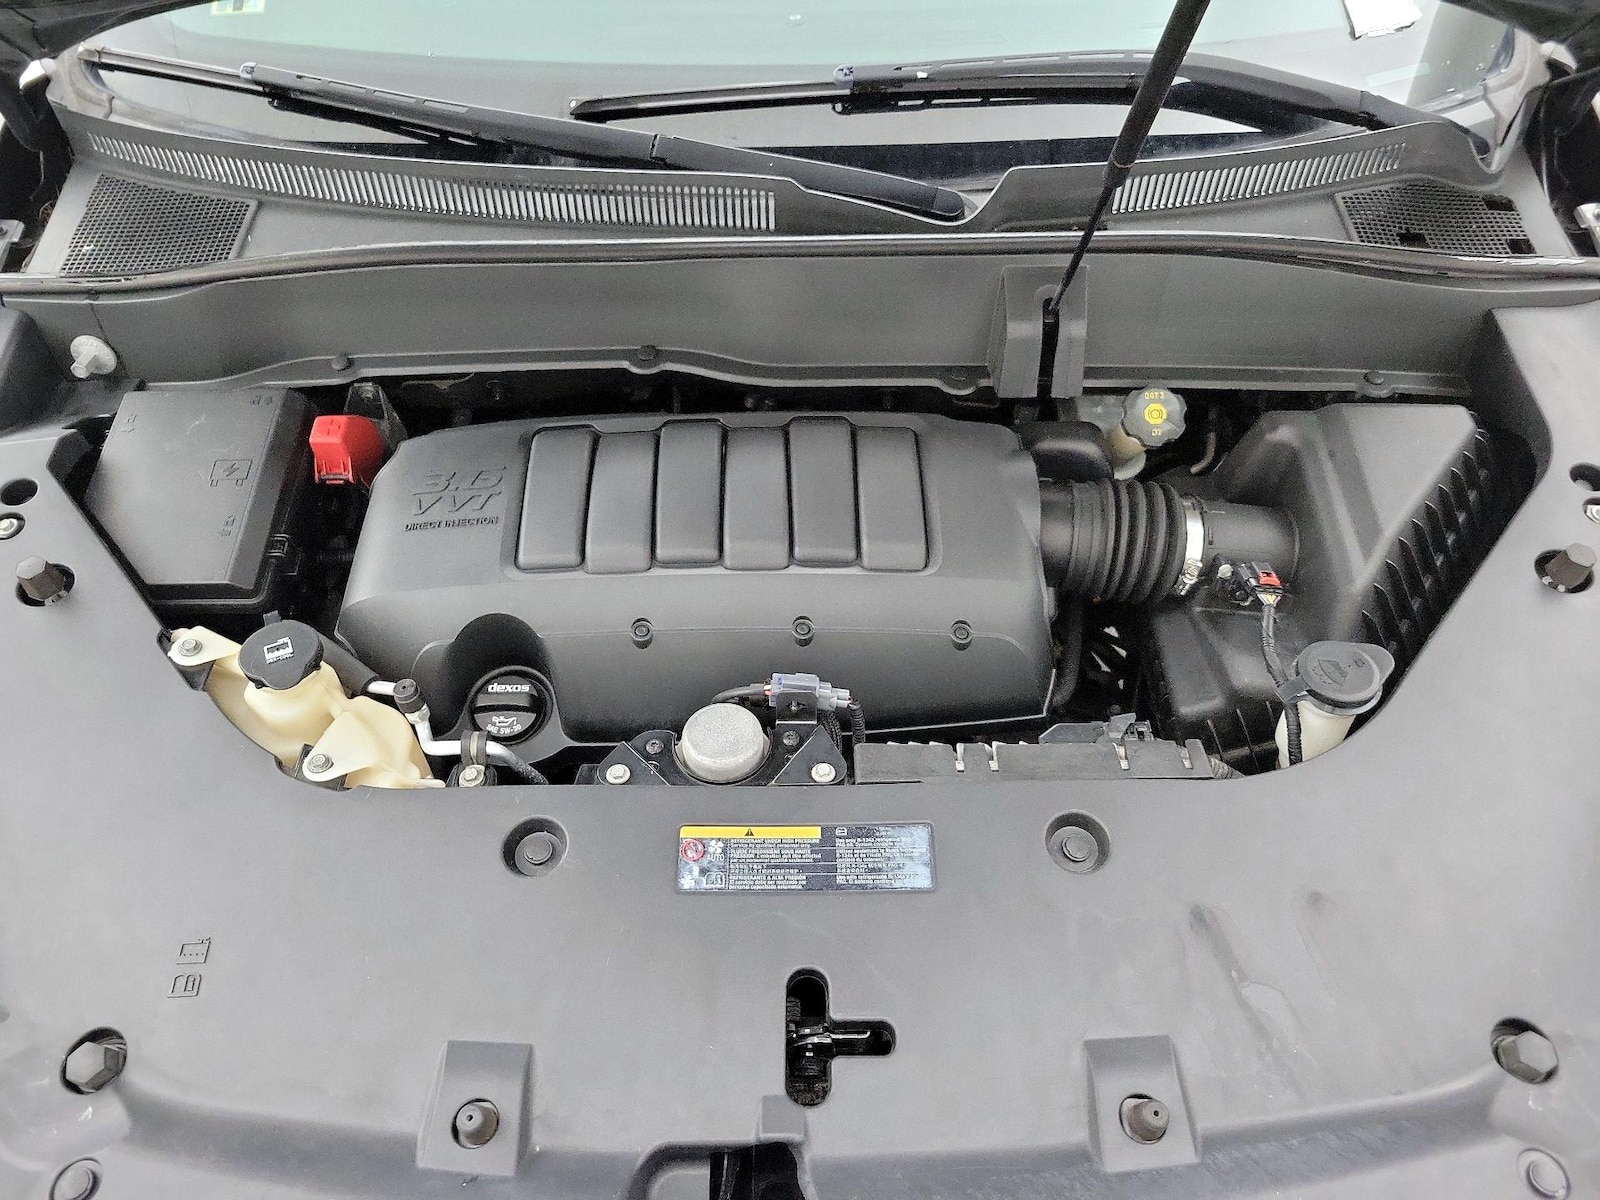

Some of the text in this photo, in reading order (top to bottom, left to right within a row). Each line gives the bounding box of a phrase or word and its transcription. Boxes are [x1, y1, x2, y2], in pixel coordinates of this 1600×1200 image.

[411, 490, 502, 516] VVT
[404, 515, 500, 532] DIRECT INJECTION
[487, 682, 532, 693] dexos
[486, 723, 522, 735] SAE 5W-30
[706, 853, 725, 861] AUTO
